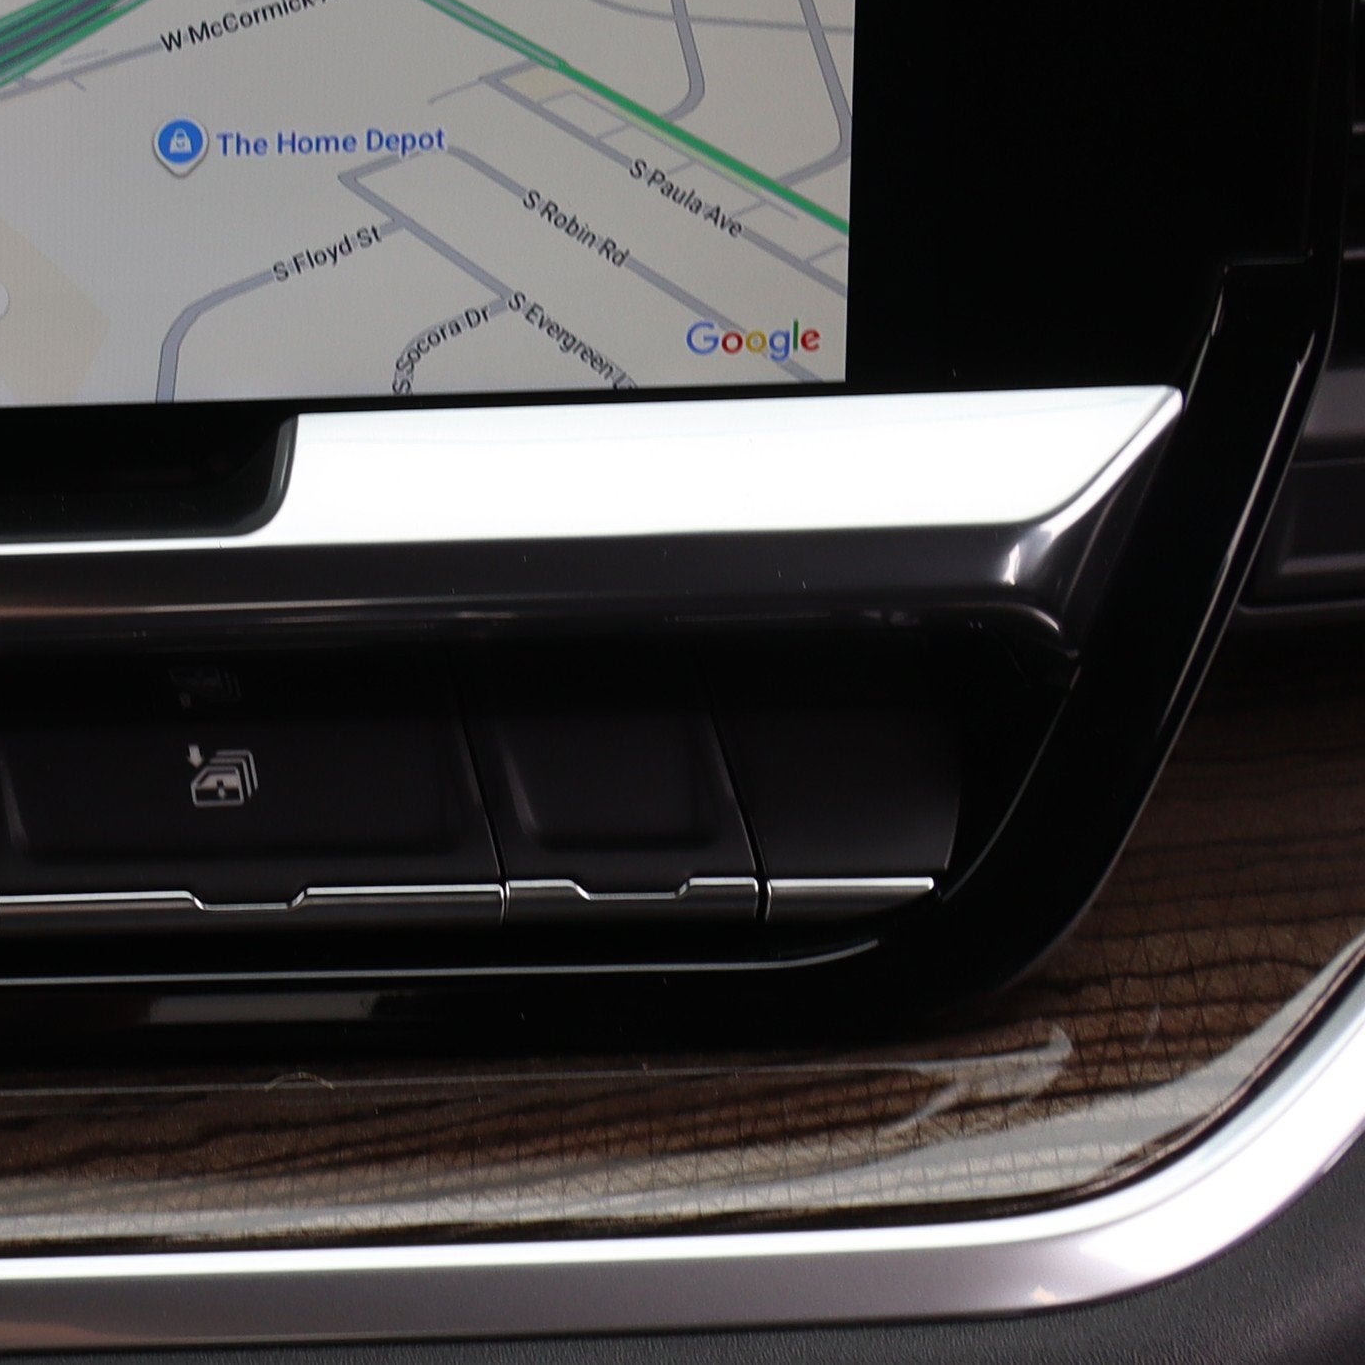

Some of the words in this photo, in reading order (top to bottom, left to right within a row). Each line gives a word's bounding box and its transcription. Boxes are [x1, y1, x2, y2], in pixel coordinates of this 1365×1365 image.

[160, 30, 183, 53] W
[216, 130, 268, 157] The
[275, 130, 358, 155] Home
[365, 127, 446, 159] Depot
[629, 158, 647, 180] S
[648, 167, 705, 217] Paula
[702, 200, 744, 239] Ave
[522, 188, 541, 211] S
[541, 197, 599, 251] Robin
[596, 235, 630, 268] Rd
[272, 260, 290, 283] S
[292, 233, 354, 271] Floyd
[355, 225, 382, 249] St
[464, 304, 490, 329] Dr
[507, 291, 526, 312] S
[525, 301, 614, 381] Evergreen
[685, 319, 821, 361] Google
[395, 319, 463, 376] Socora
[392, 379, 411, 395] S
